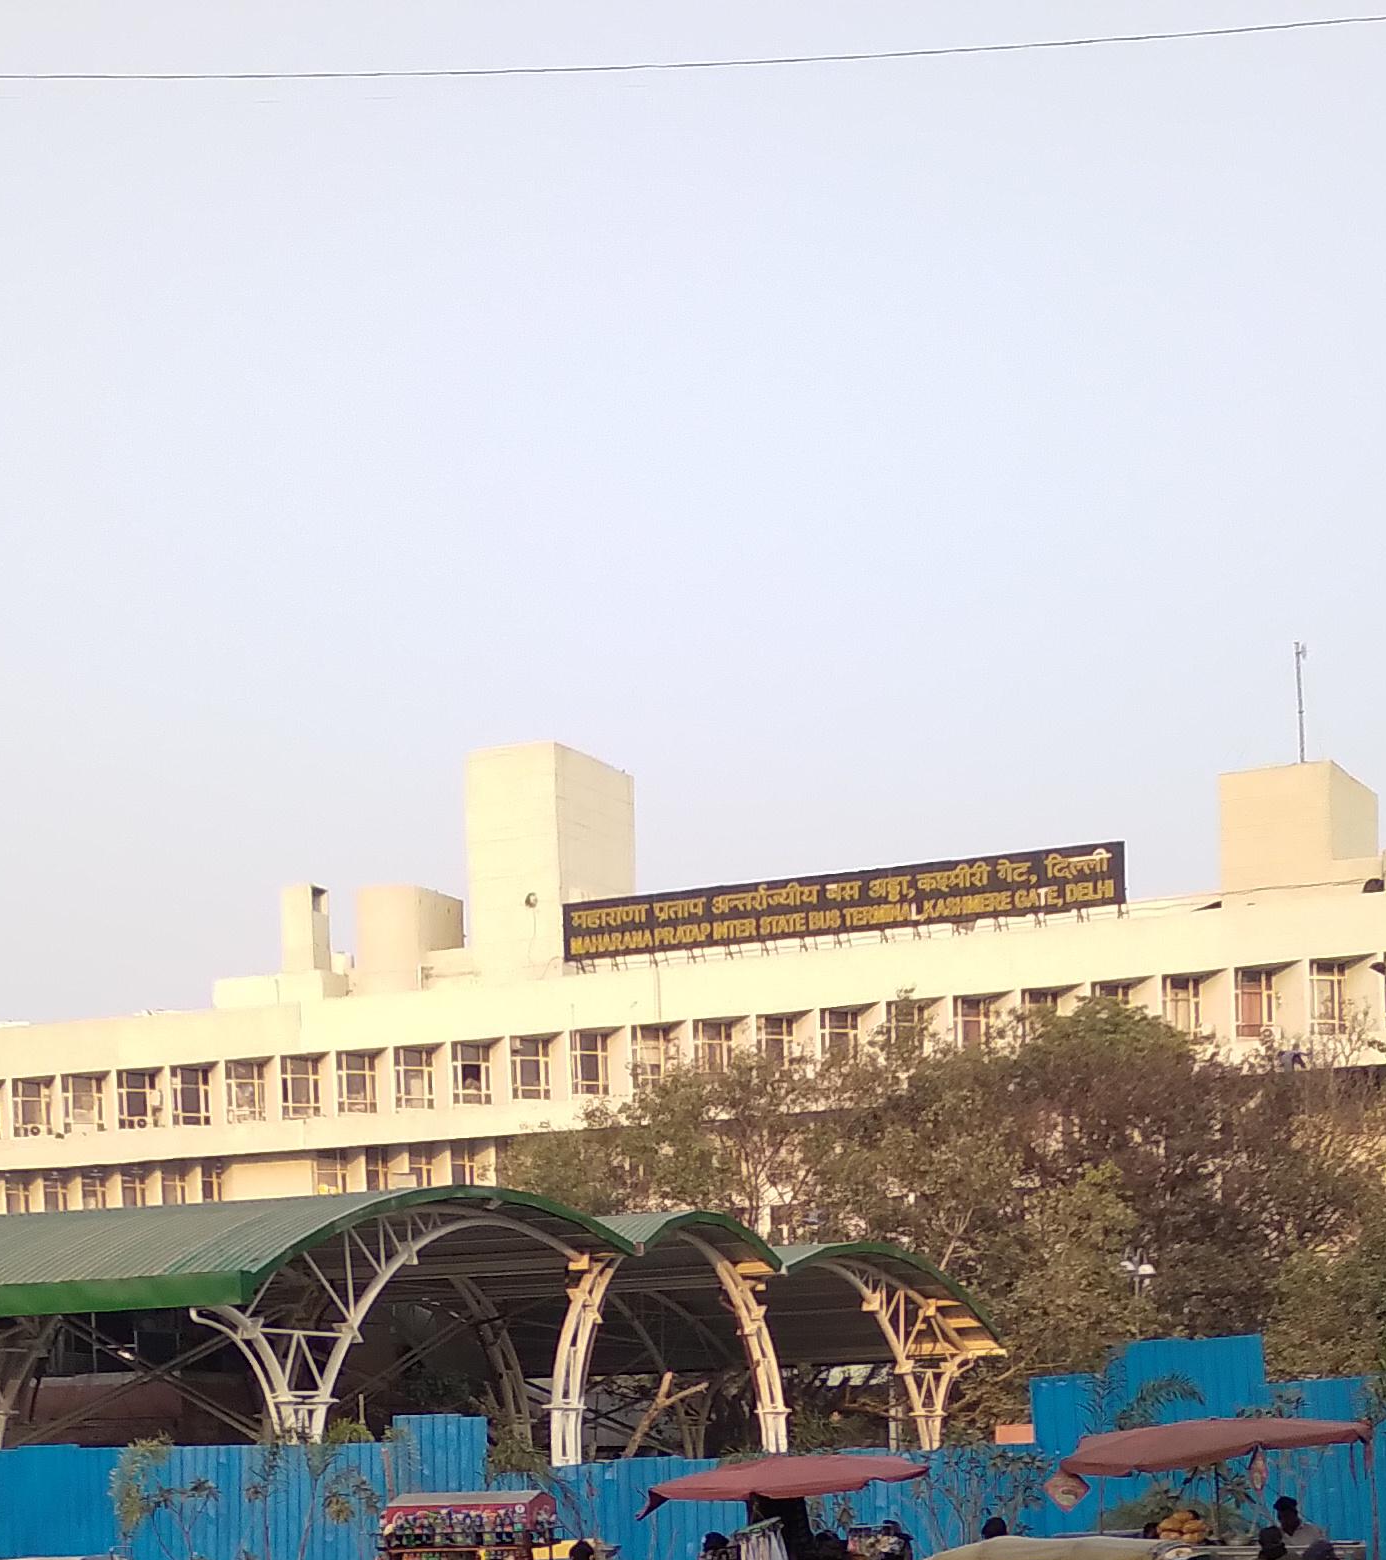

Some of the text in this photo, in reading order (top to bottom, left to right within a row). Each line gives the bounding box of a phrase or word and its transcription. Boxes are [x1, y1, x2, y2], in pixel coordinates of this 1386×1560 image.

[570, 928, 652, 956] MAHARANA
[653, 922, 711, 946] PRATAP
[714, 918, 757, 940] INTER
[760, 912, 806, 935] STATE
[808, 909, 841, 930] BUS
[1065, 879, 1115, 904] DELHI
[571, 903, 650, 929] महाराणा
[653, 897, 707, 923] प्रताप
[825, 880, 862, 901] बस
[996, 859, 1038, 884] गेट,
[1044, 848, 1113, 879] दिल्ली
